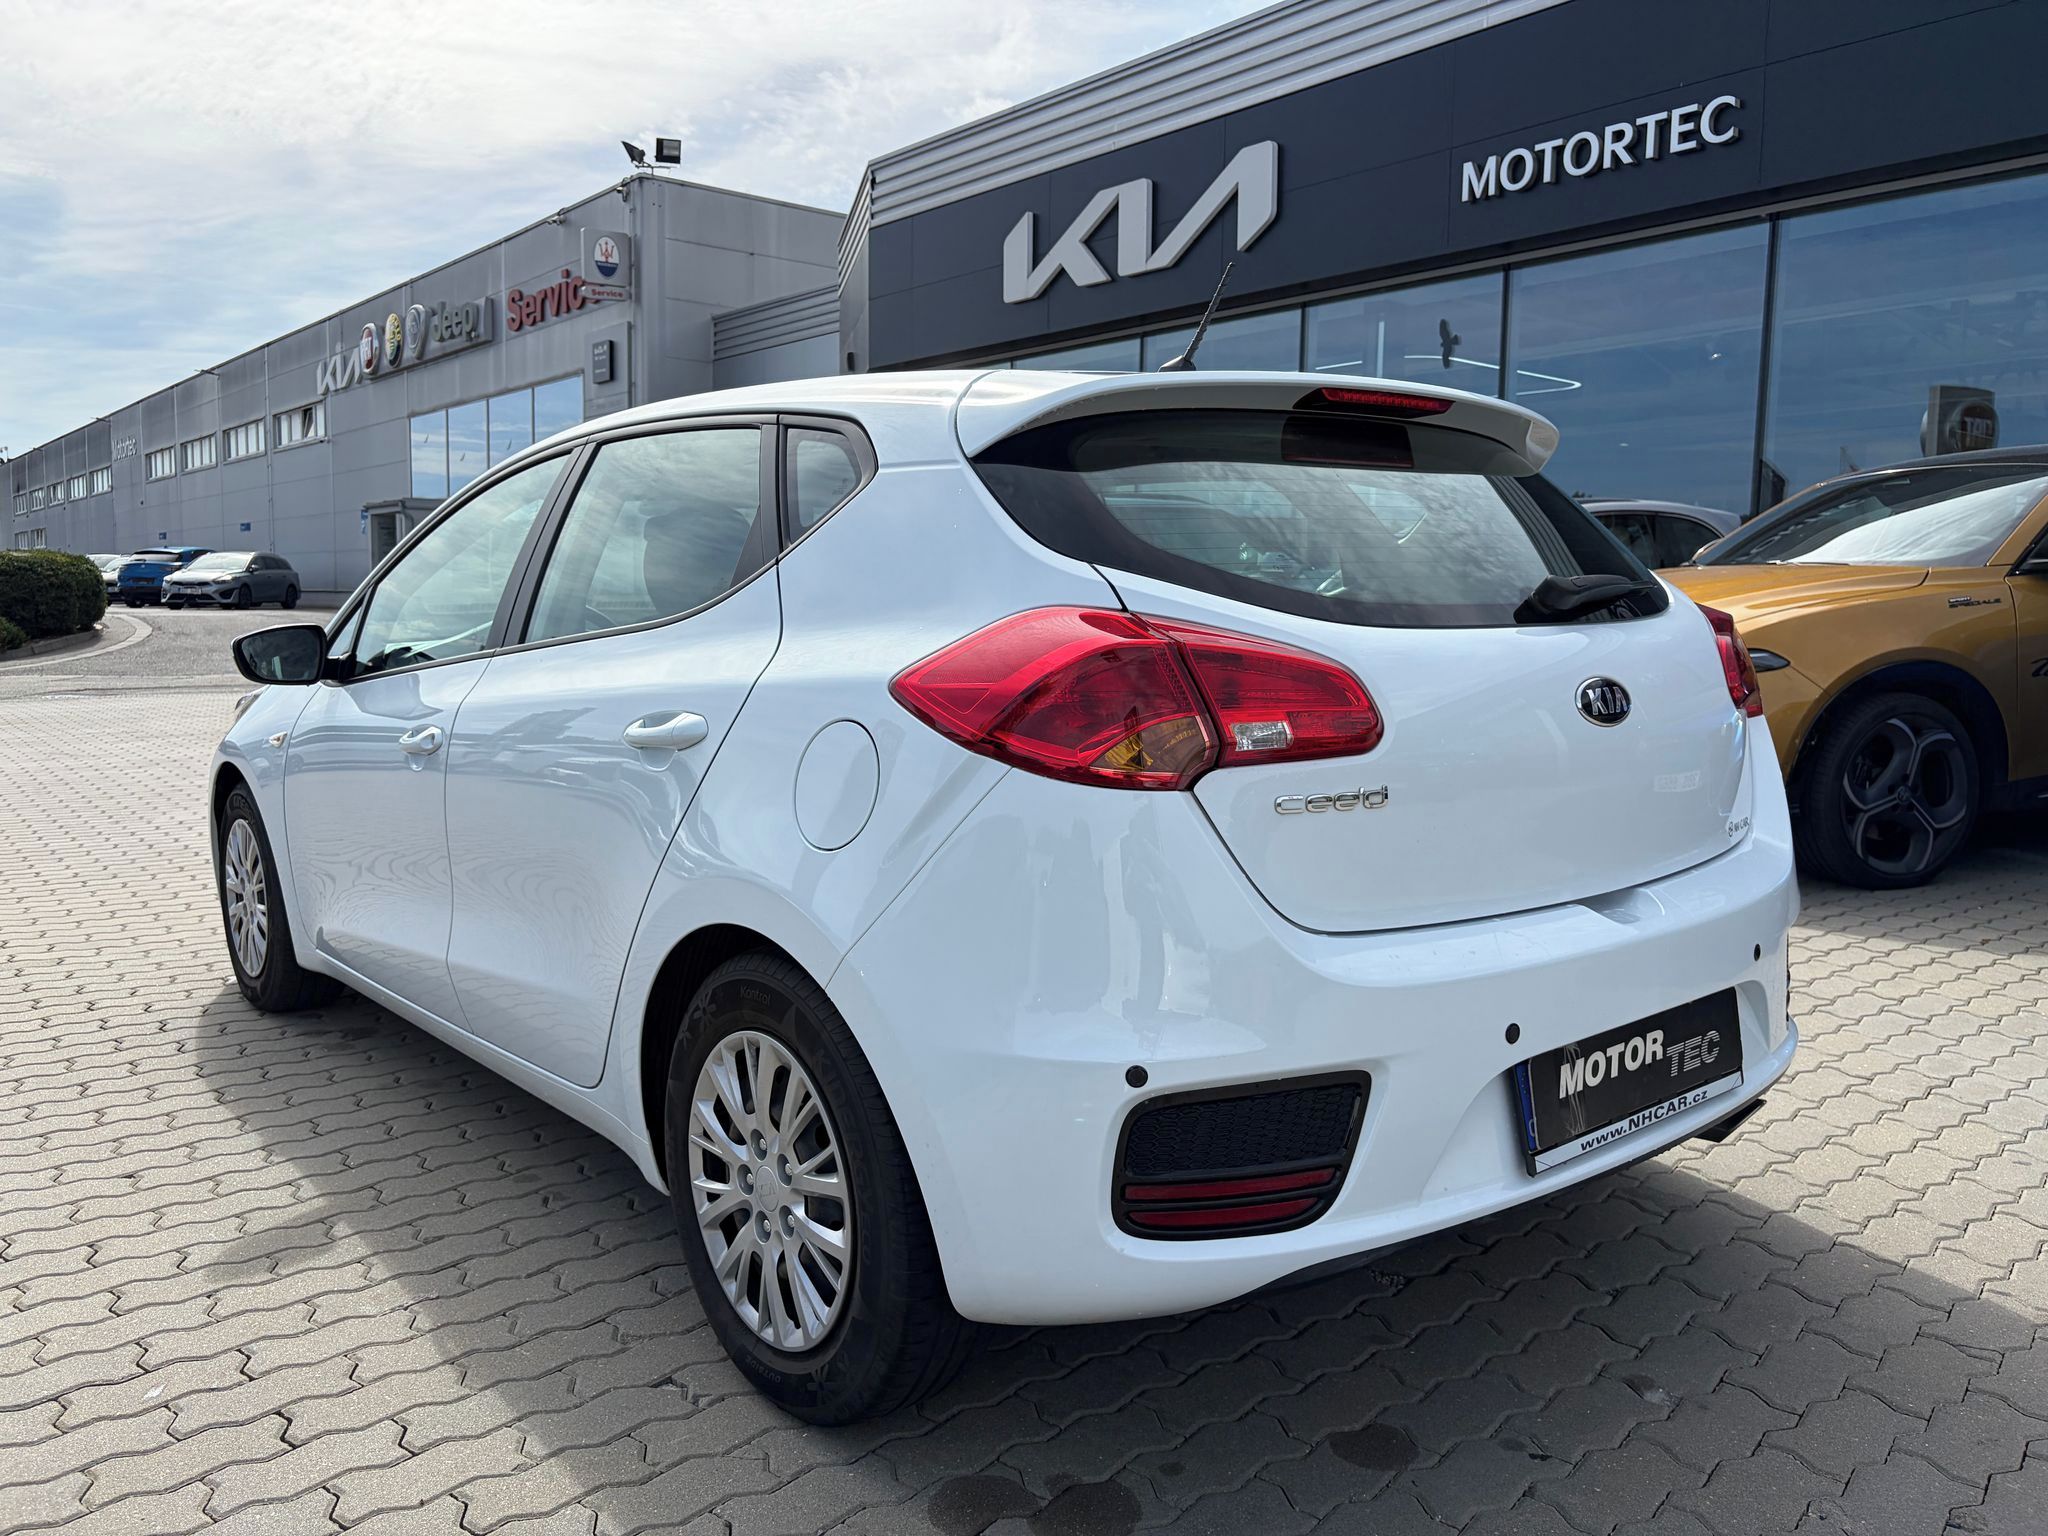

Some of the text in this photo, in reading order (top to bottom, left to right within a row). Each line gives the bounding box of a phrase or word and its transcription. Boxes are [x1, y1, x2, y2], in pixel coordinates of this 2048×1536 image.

[1460, 95, 1741, 203] MOTORTEC
[1003, 140, 1278, 303] KIA
[431, 301, 476, 342] Jeep
[508, 268, 598, 332] Servic
[591, 288, 624, 298] Service
[112, 436, 137, 461] Motortec
[1586, 686, 1628, 715] KIA
[1559, 1029, 1720, 1099] MOTOR TEC
[1580, 1090, 1708, 1151] www.NHCAR.cz
